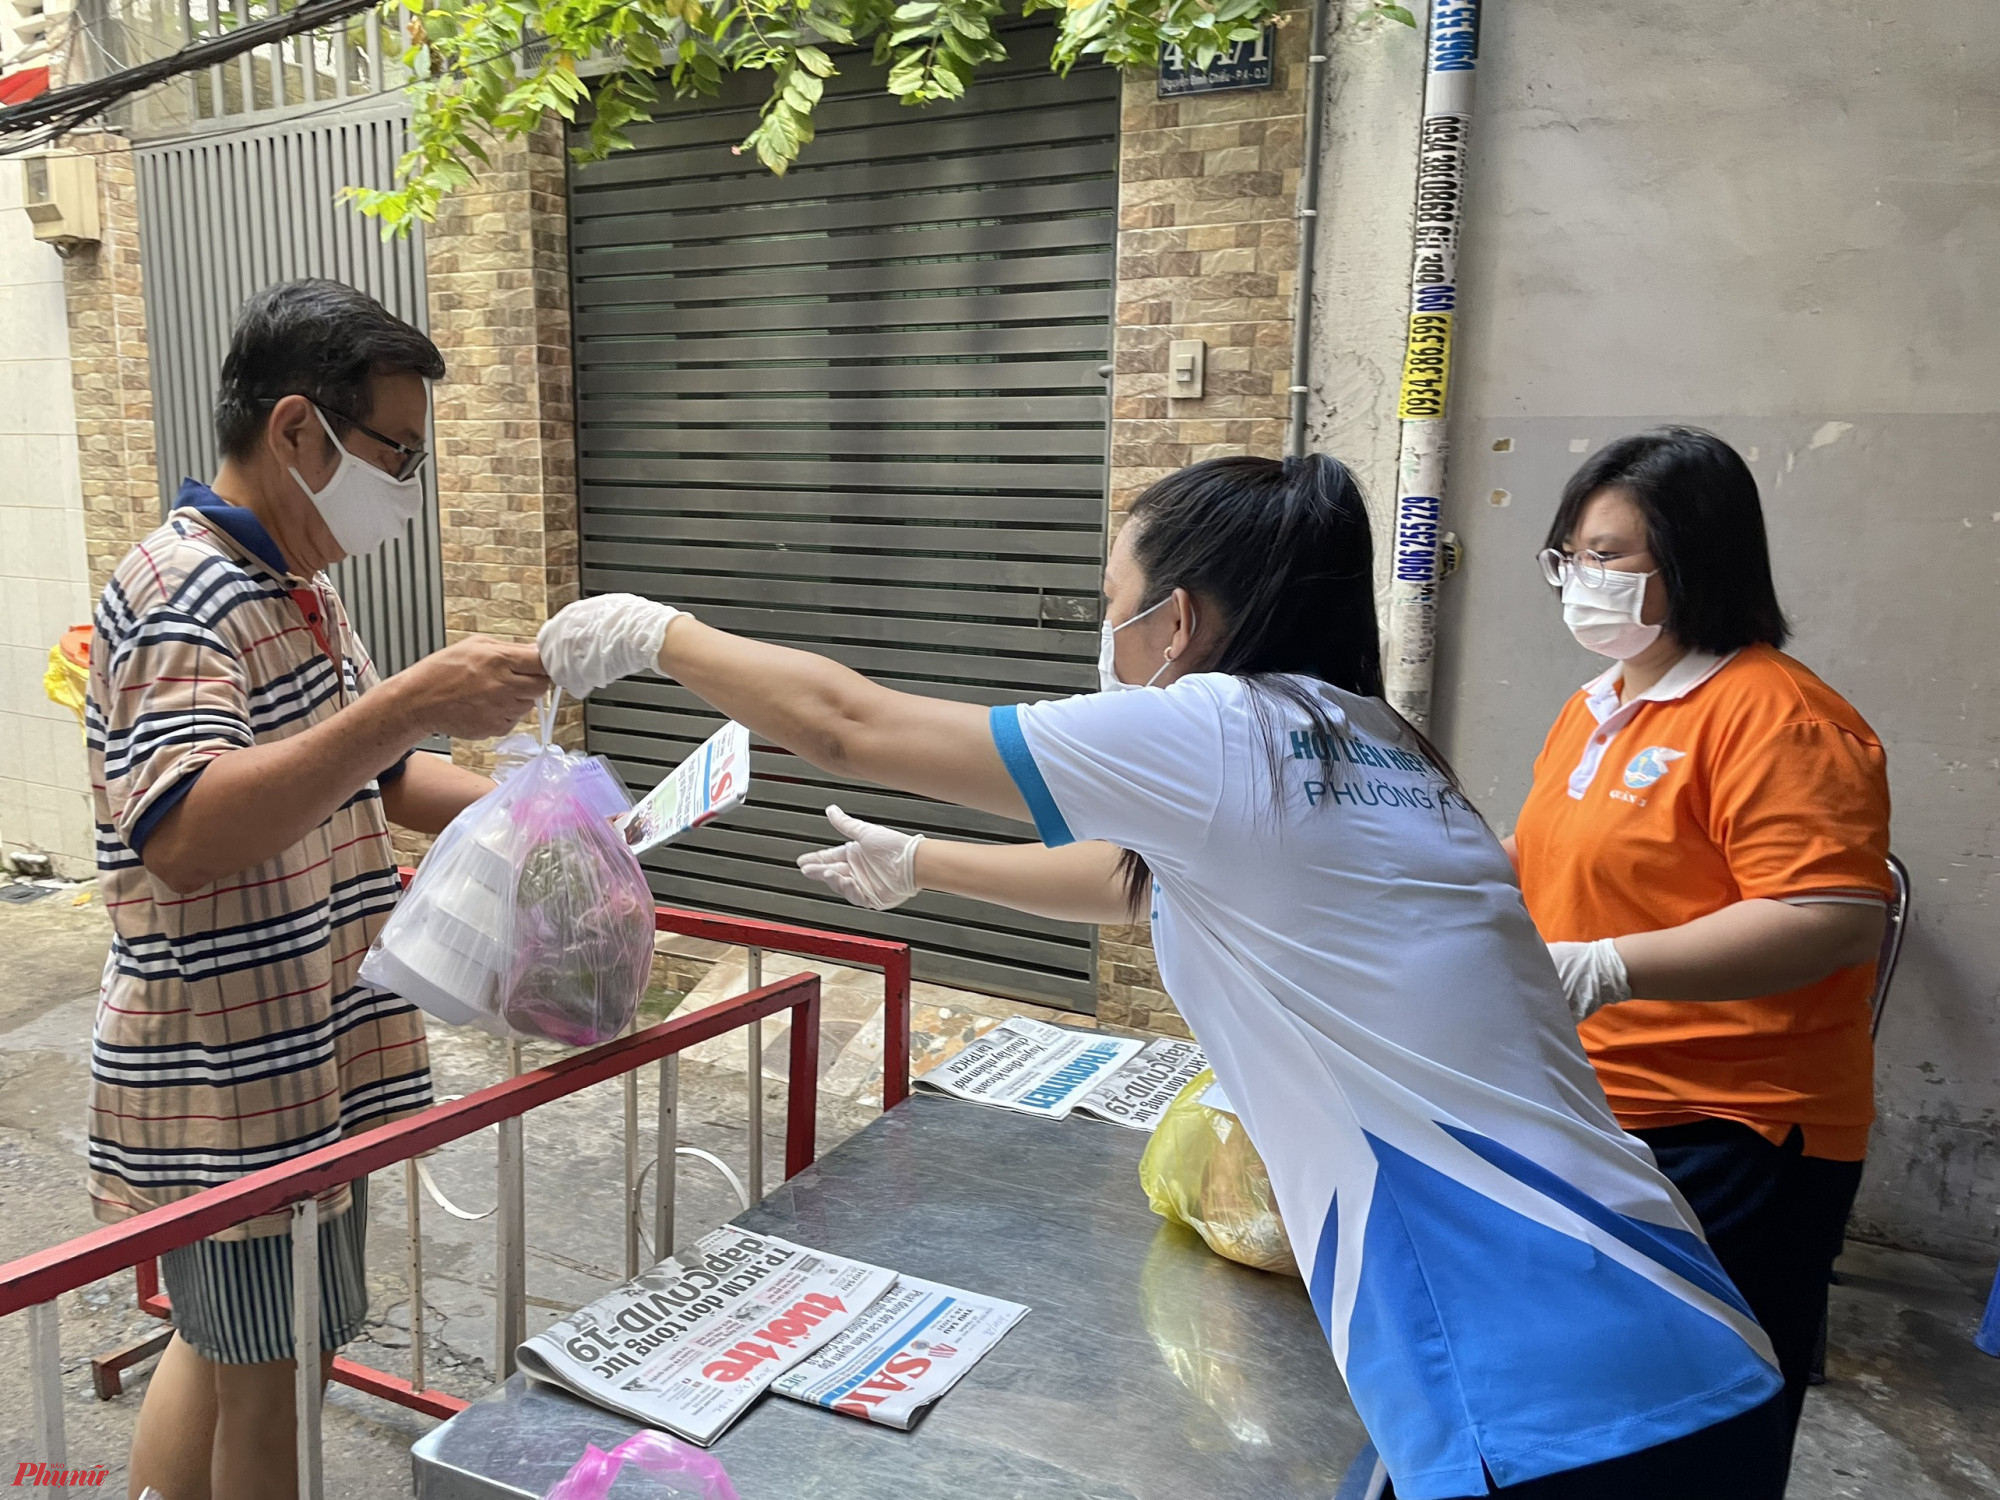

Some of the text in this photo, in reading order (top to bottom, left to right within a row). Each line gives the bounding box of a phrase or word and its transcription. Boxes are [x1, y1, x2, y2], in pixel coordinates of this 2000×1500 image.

[1424, 116, 1460, 153] 0934
[1419, 181, 1457, 222] 0868
[1406, 316, 1448, 415] 0934.386.599
[1401, 496, 1441, 521] 229
[1400, 522, 1438, 548] 255
[1397, 549, 1436, 581] 0906
[718, 1247, 796, 1298] TP.HCM
[566, 1267, 719, 1362] COVID-19
[679, 1293, 724, 1323] dồn
[624, 1321, 688, 1356] tổng
[592, 1352, 641, 1379] lực
